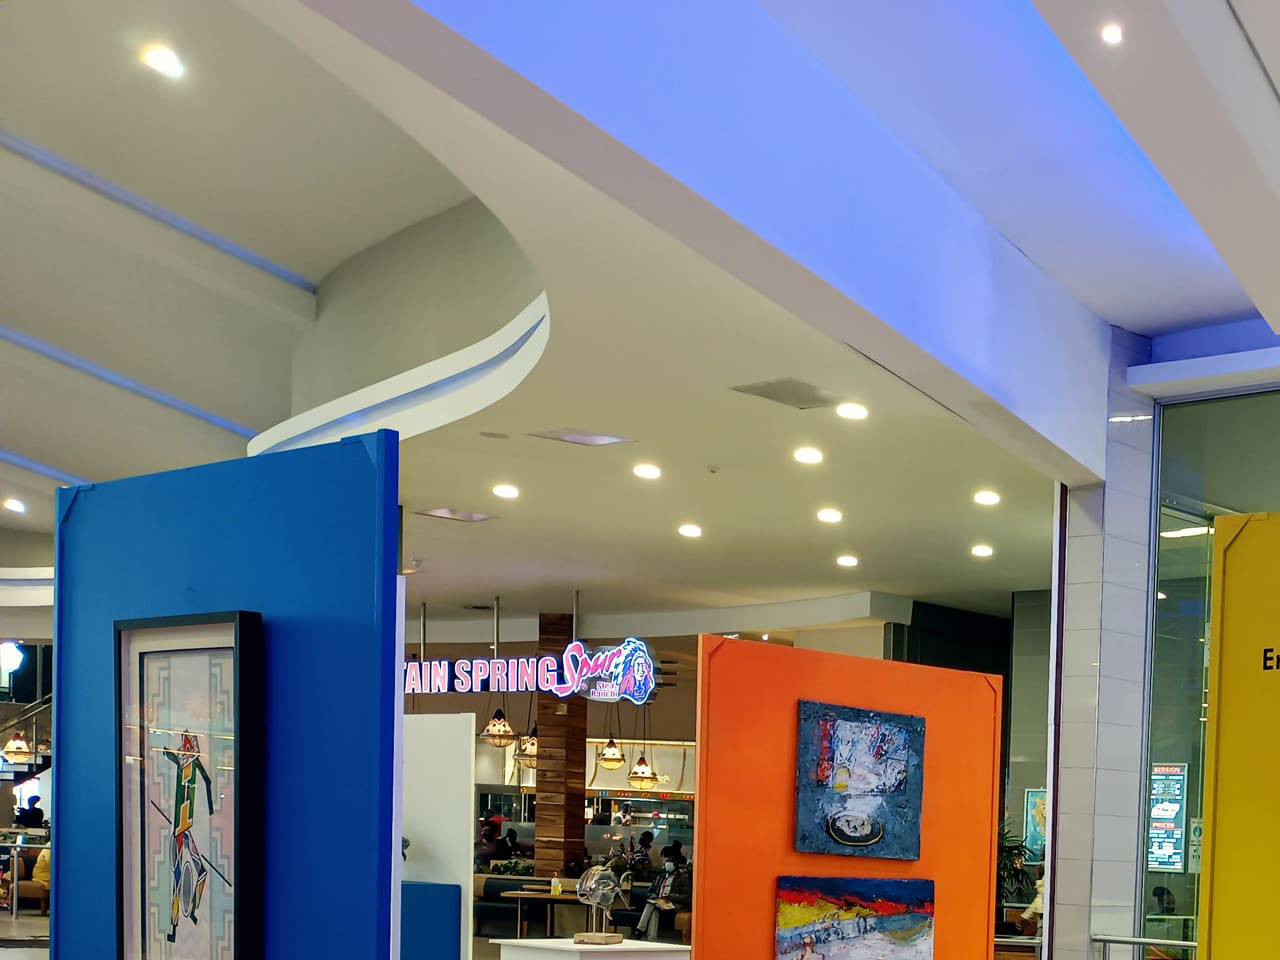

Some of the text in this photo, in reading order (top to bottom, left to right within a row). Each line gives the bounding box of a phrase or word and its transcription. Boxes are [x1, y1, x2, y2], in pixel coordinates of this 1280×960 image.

[403, 658, 557, 693] AIN SPRING
[554, 641, 622, 698] Spur
